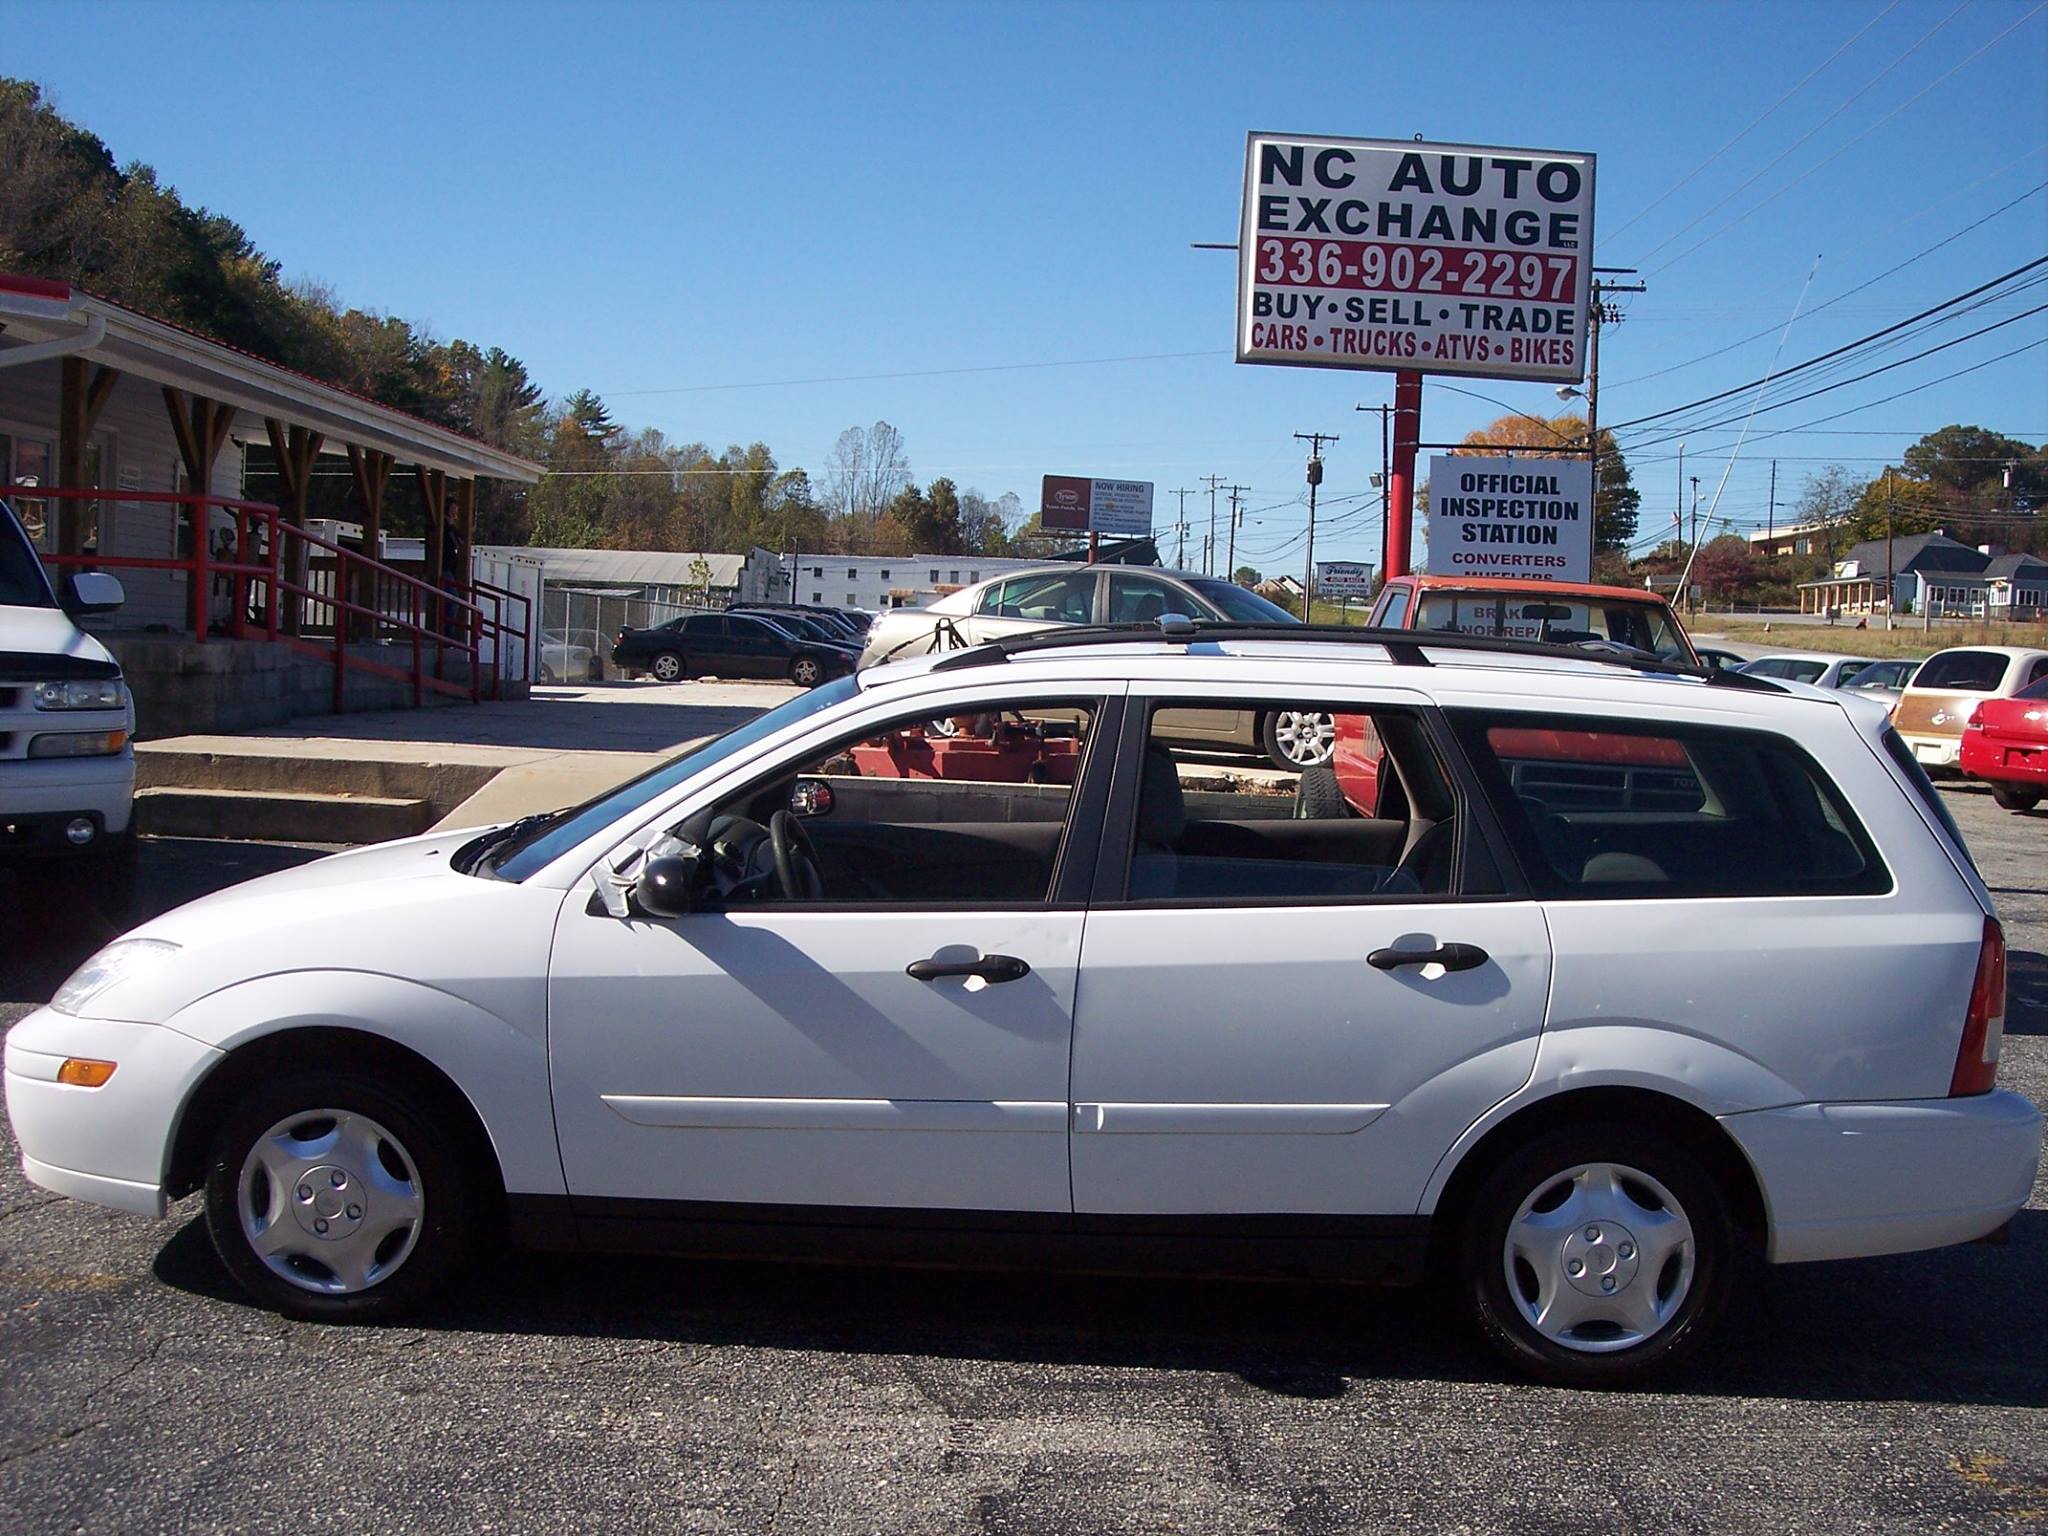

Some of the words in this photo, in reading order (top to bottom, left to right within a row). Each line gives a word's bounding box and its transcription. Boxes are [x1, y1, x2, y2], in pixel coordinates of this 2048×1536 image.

[1260, 145, 1357, 189] NC
[1387, 153, 1582, 203] AUTO
[1258, 195, 1580, 248] EXCHANGE
[1259, 239, 1572, 300] 336-902-2297
[1253, 291, 1325, 320] BUY
[1344, 297, 1432, 326] SELL
[1459, 303, 1576, 335] TRADE
[1251, 322, 1309, 351] CARS
[1329, 327, 1417, 357] TRUCKS
[1433, 333, 1489, 361] ATVS
[1509, 338, 1575, 366] BIKES
[1095, 482, 1114, 491] NOW
[1116, 483, 1144, 493] HIRING
[1460, 473, 1561, 495] OFFICIAL
[1440, 497, 1579, 521] INSPECTION
[1461, 523, 1558, 545] STATION
[1452, 552, 1567, 567] CONVERTERS
